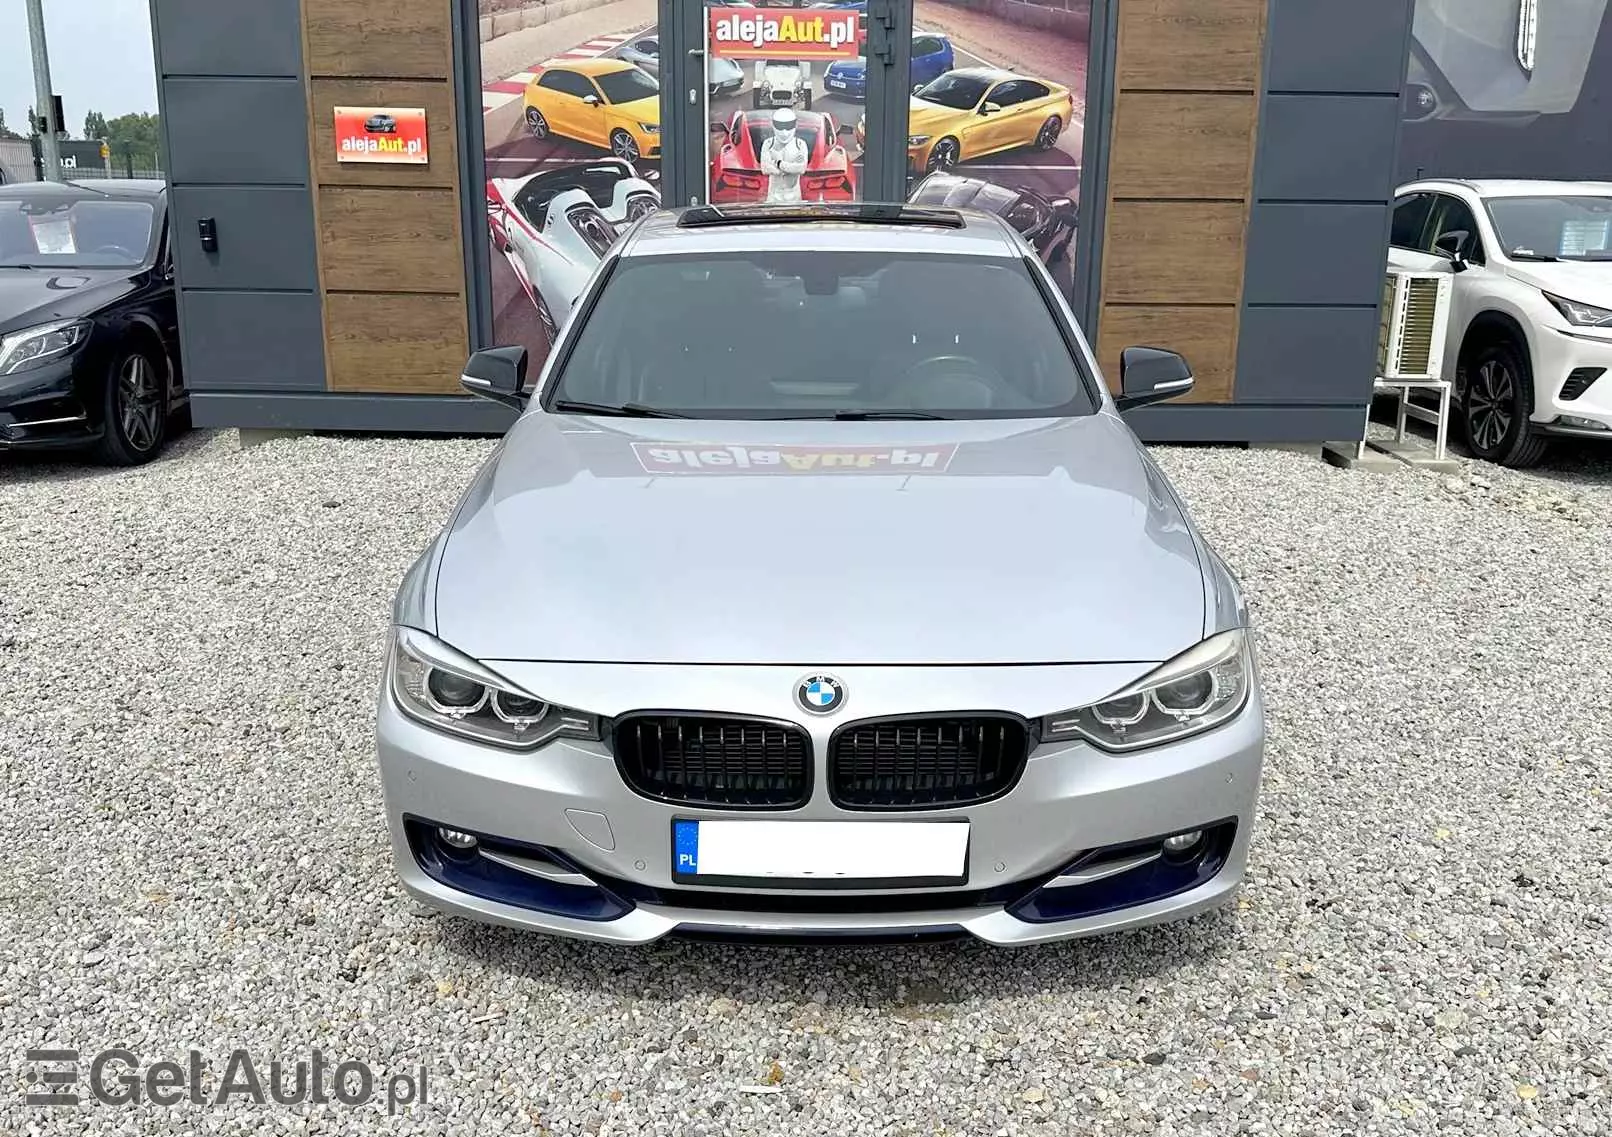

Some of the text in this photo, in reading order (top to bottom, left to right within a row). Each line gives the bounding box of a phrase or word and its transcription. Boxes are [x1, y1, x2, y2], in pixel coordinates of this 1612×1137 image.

[715, 14, 855, 48] alejaAut.pl
[341, 136, 422, 155] alejaAut.pl
[801, 675, 840, 688] BMW
[679, 853, 697, 866] PL
